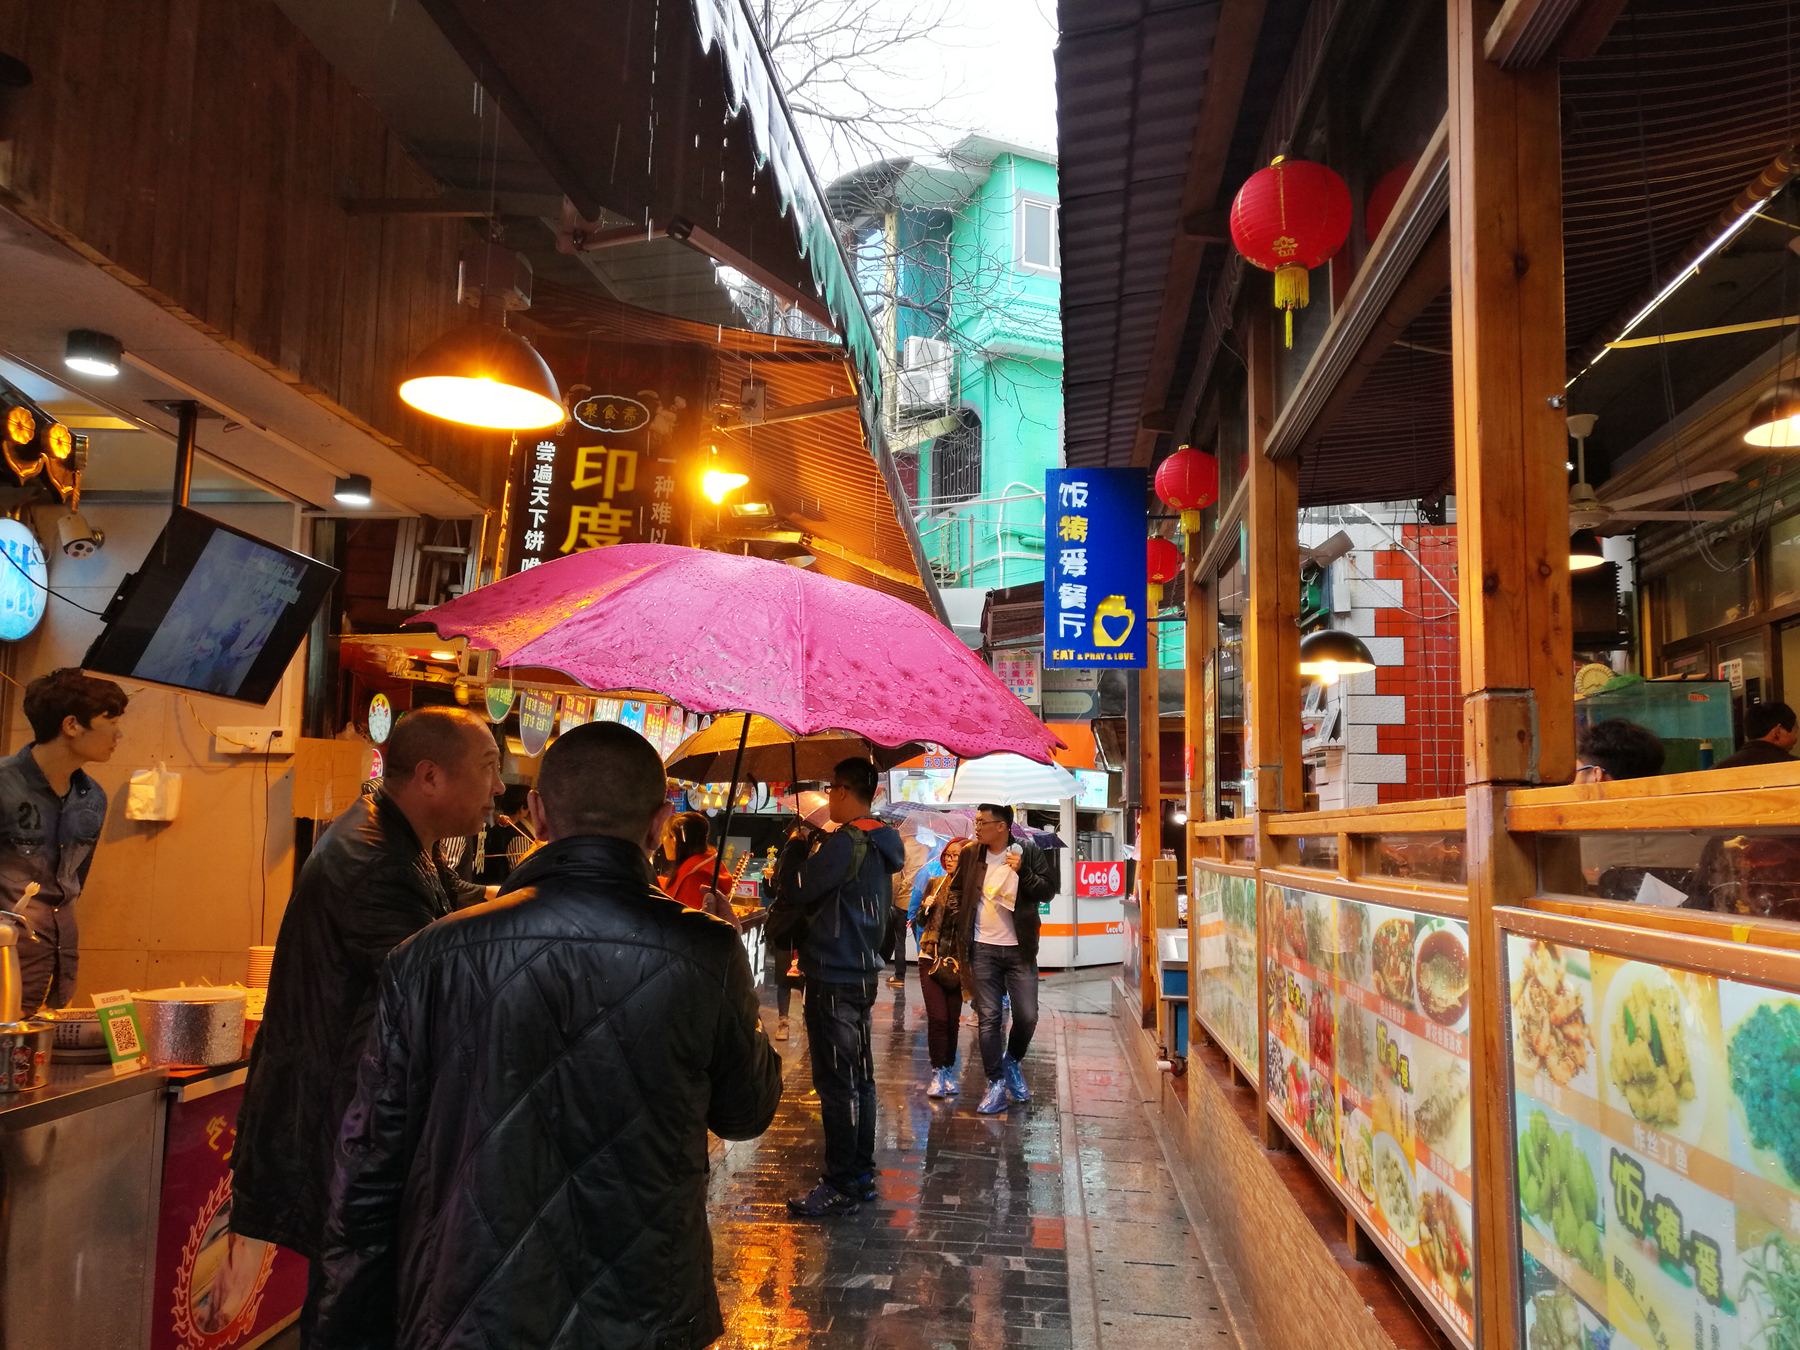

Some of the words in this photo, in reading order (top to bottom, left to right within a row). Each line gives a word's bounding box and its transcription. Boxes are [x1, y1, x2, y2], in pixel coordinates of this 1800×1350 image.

[558, 444, 639, 554] 印度
[1057, 480, 1090, 639] 饭祷爱餐厅
[1052, 649, 1075, 661] EAT
[1077, 653, 1084, 661] &
[1084, 652, 1106, 661] PRAY
